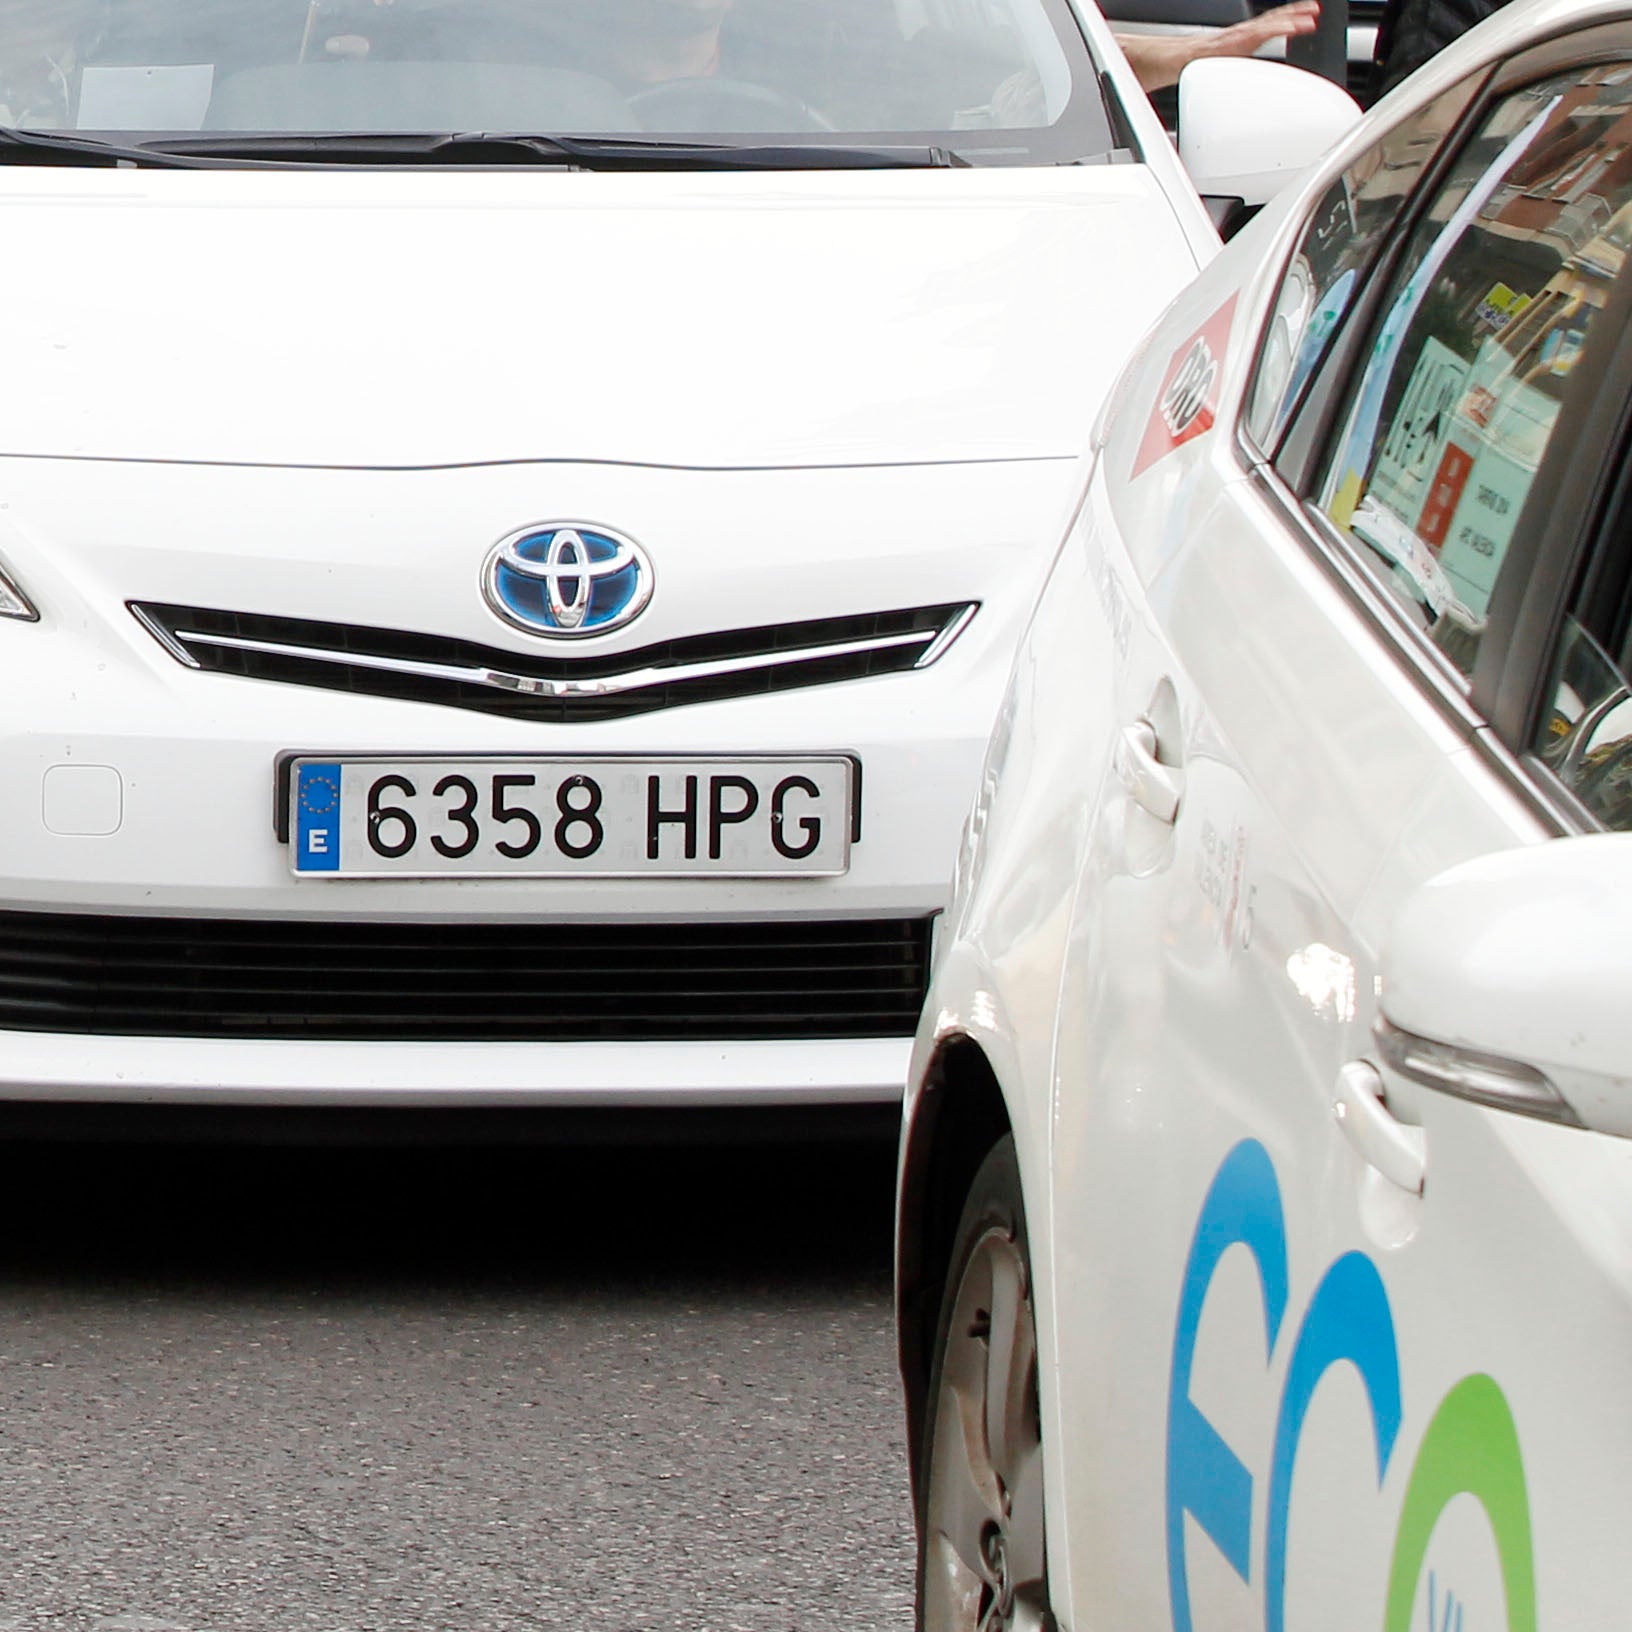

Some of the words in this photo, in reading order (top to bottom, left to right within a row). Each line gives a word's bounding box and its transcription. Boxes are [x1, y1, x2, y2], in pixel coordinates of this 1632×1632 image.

[308, 828, 329, 854] E
[366, 774, 605, 861] 6358
[645, 774, 821, 861] HPG
